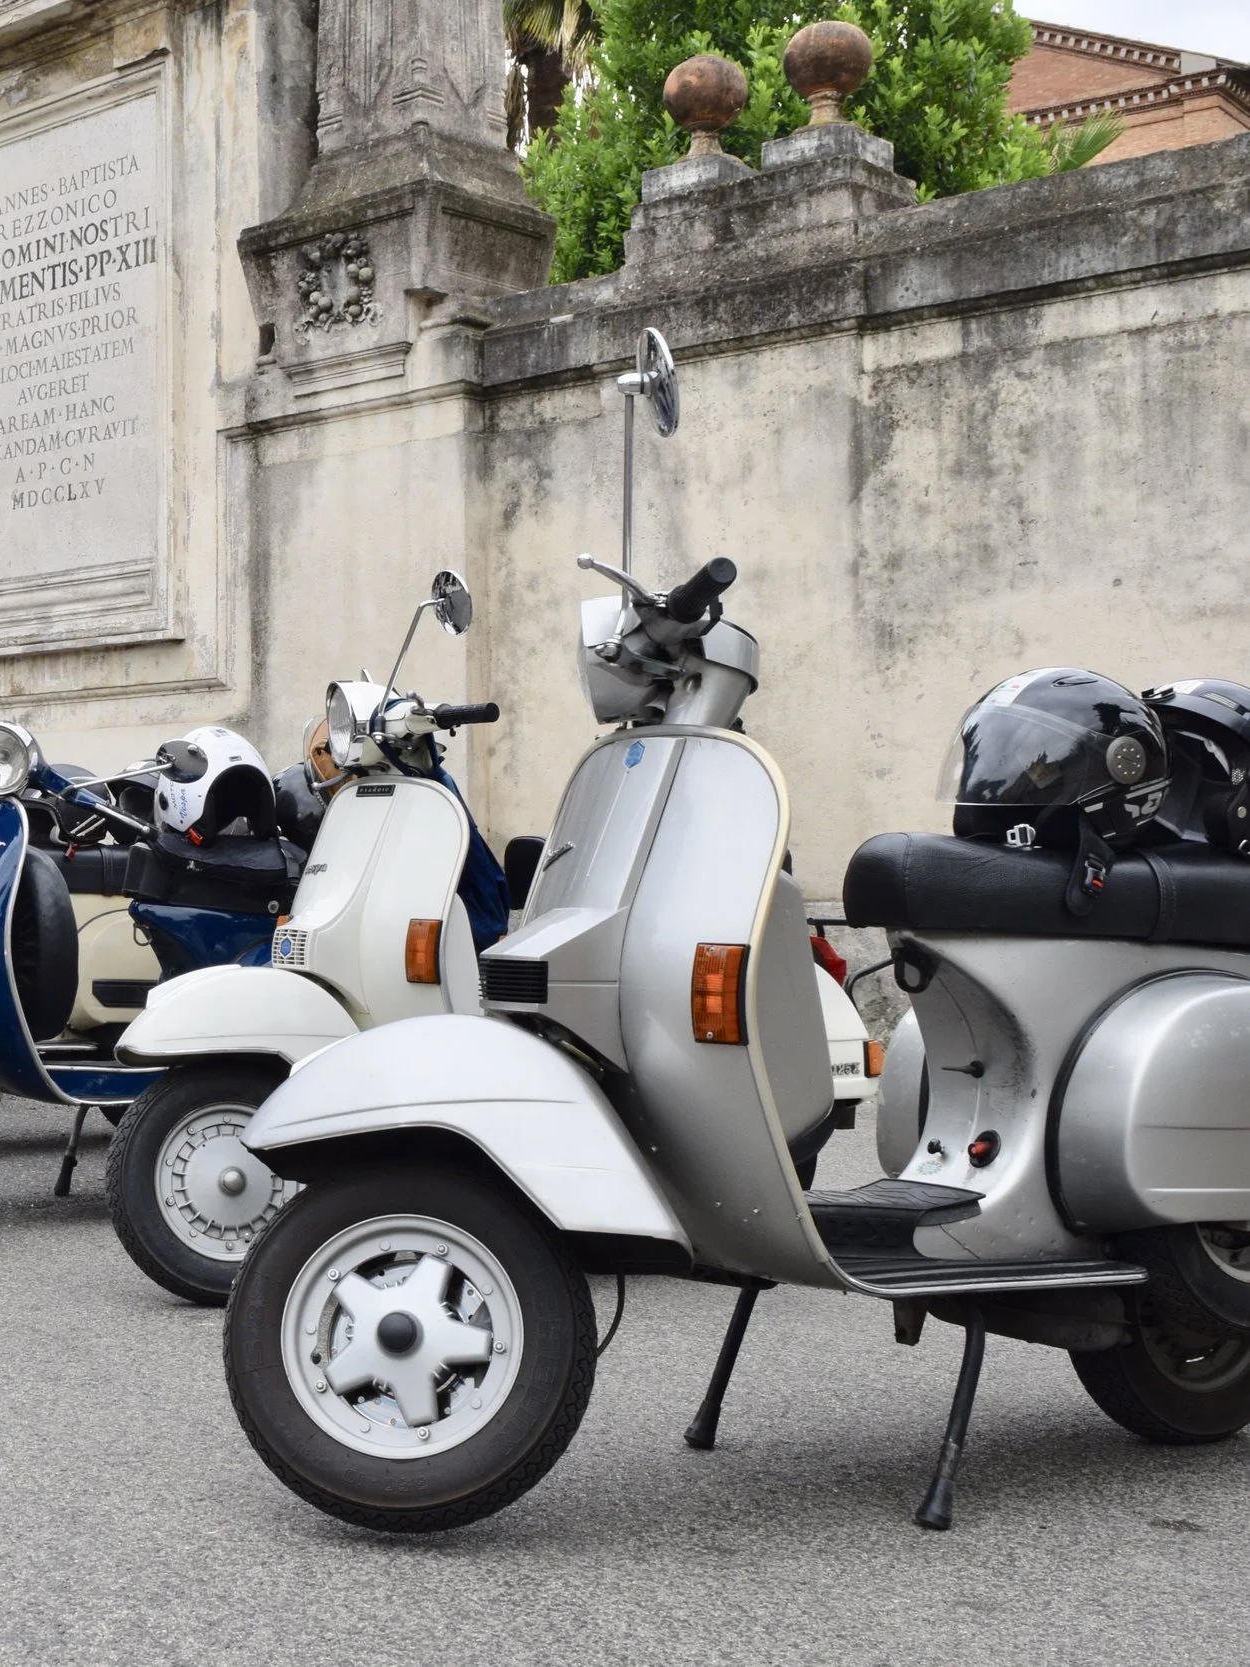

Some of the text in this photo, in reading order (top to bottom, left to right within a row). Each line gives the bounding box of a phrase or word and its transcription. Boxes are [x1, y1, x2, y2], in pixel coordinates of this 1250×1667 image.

[58, 154, 140, 196] BAPTISTA
[16, 373, 90, 406] AVGERET
[65, 394, 116, 422] HANC
